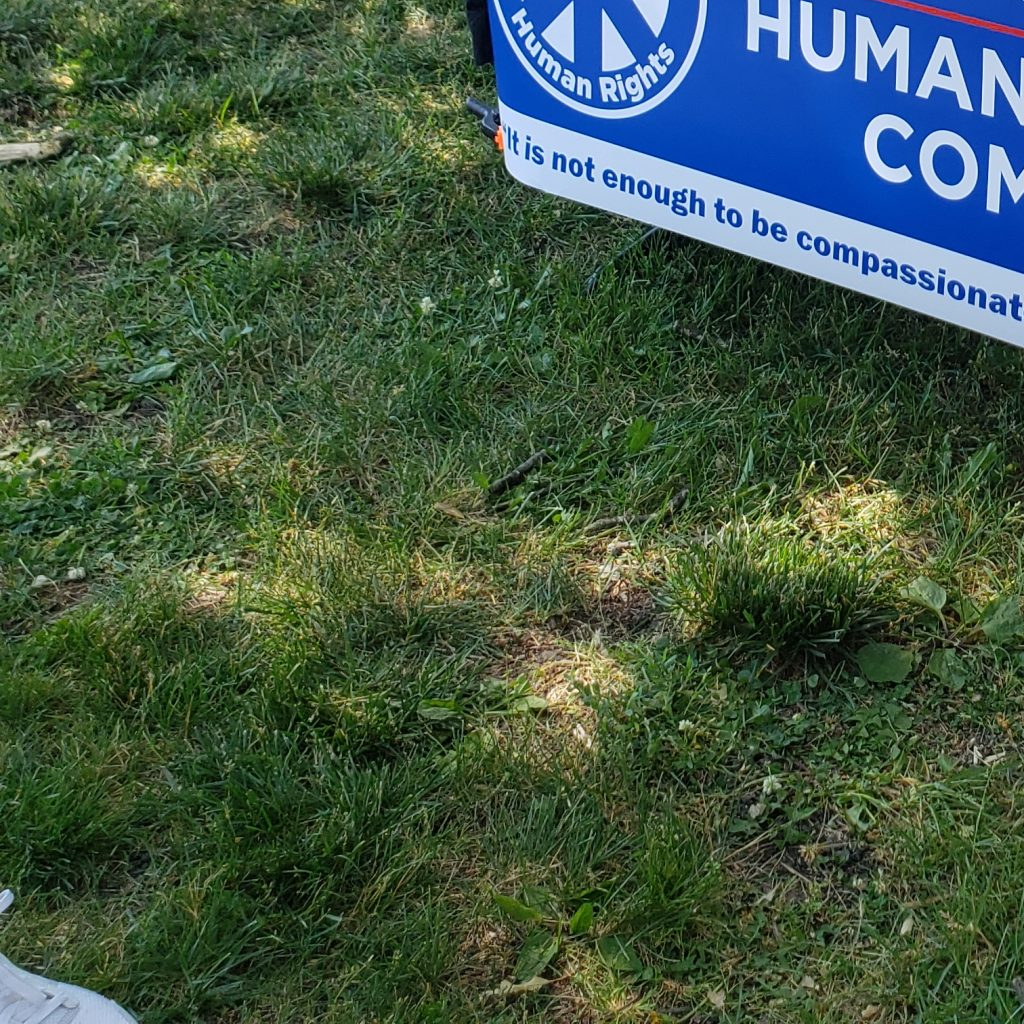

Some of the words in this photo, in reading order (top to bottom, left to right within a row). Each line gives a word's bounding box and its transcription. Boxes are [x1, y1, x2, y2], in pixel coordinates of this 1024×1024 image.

[511, 7, 592, 99] Human
[599, 42, 675, 103] Rights
[524, 135, 544, 166] is
[552, 151, 595, 183] not
[602, 168, 706, 217] enough
[714, 197, 743, 228] to
[752, 209, 788, 243] be
